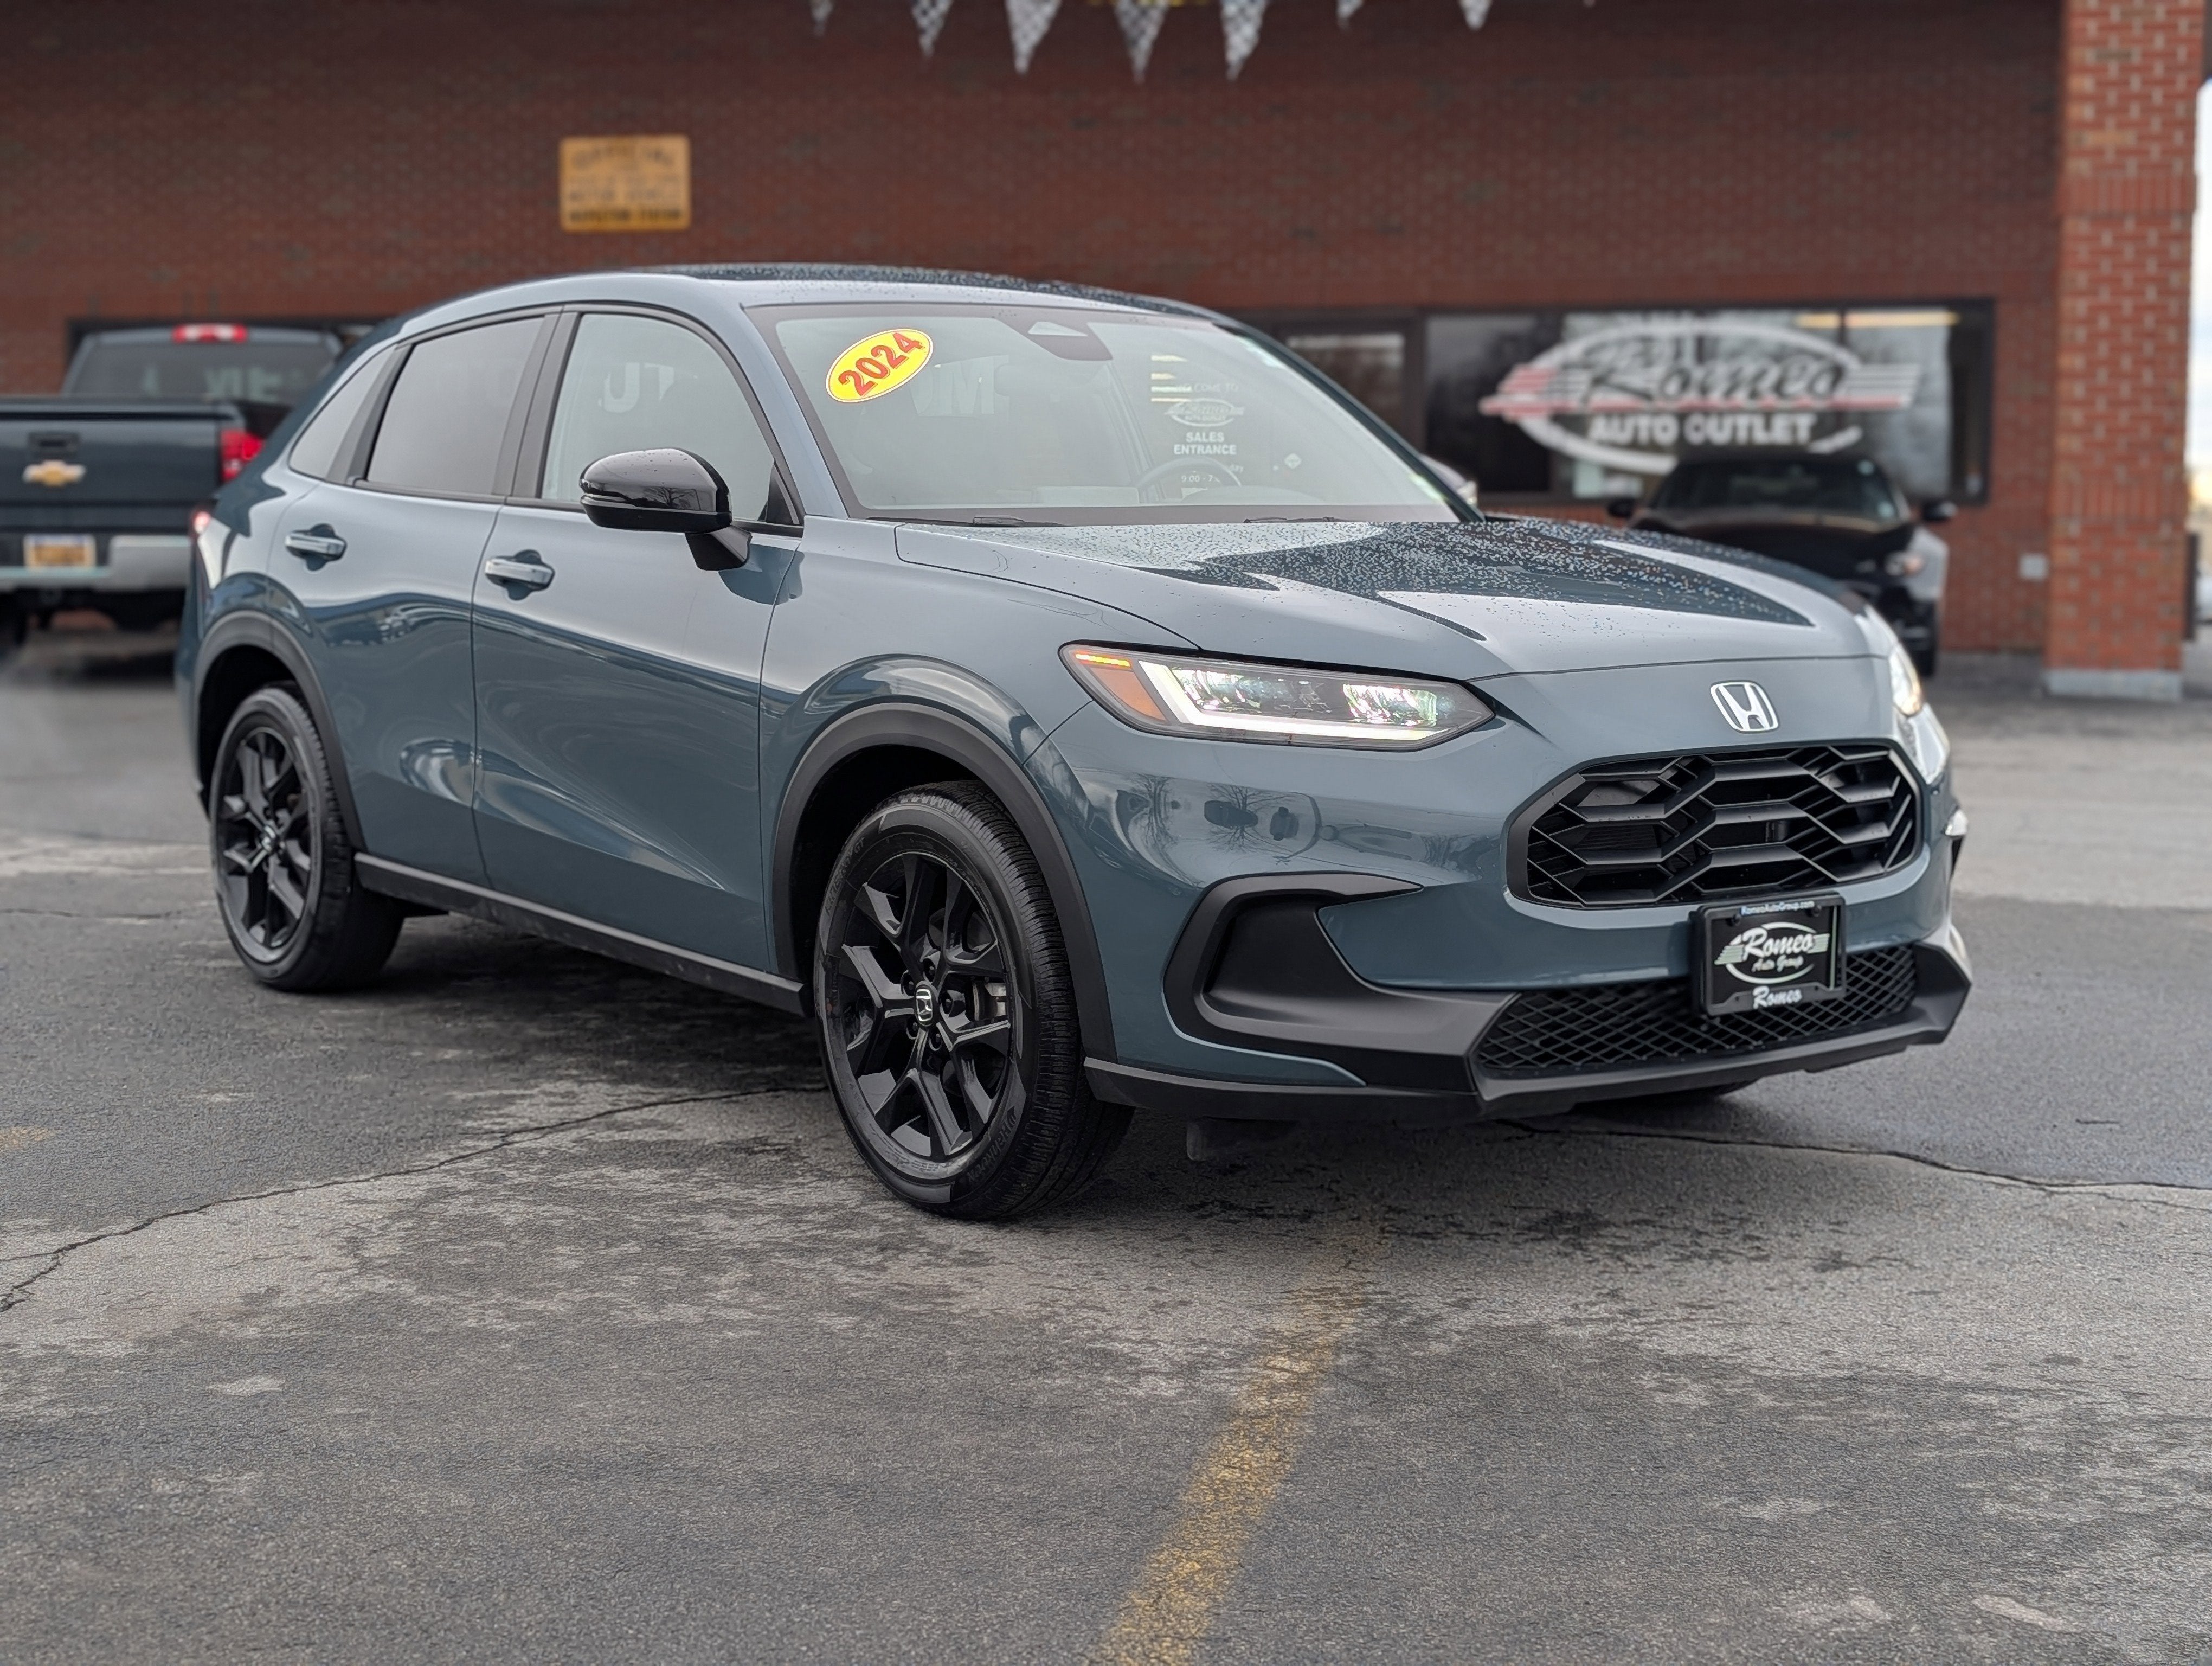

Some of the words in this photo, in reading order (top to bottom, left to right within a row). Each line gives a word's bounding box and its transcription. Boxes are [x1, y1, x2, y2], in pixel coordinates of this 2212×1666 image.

[838, 332, 924, 396] 2024
[1186, 432, 1224, 443] SALES
[1588, 413, 1676, 444] AUTO
[1683, 413, 1817, 444] OUTLET
[1174, 444, 1237, 455] ENTRANCE
[1743, 927, 1813, 962] Romeo
